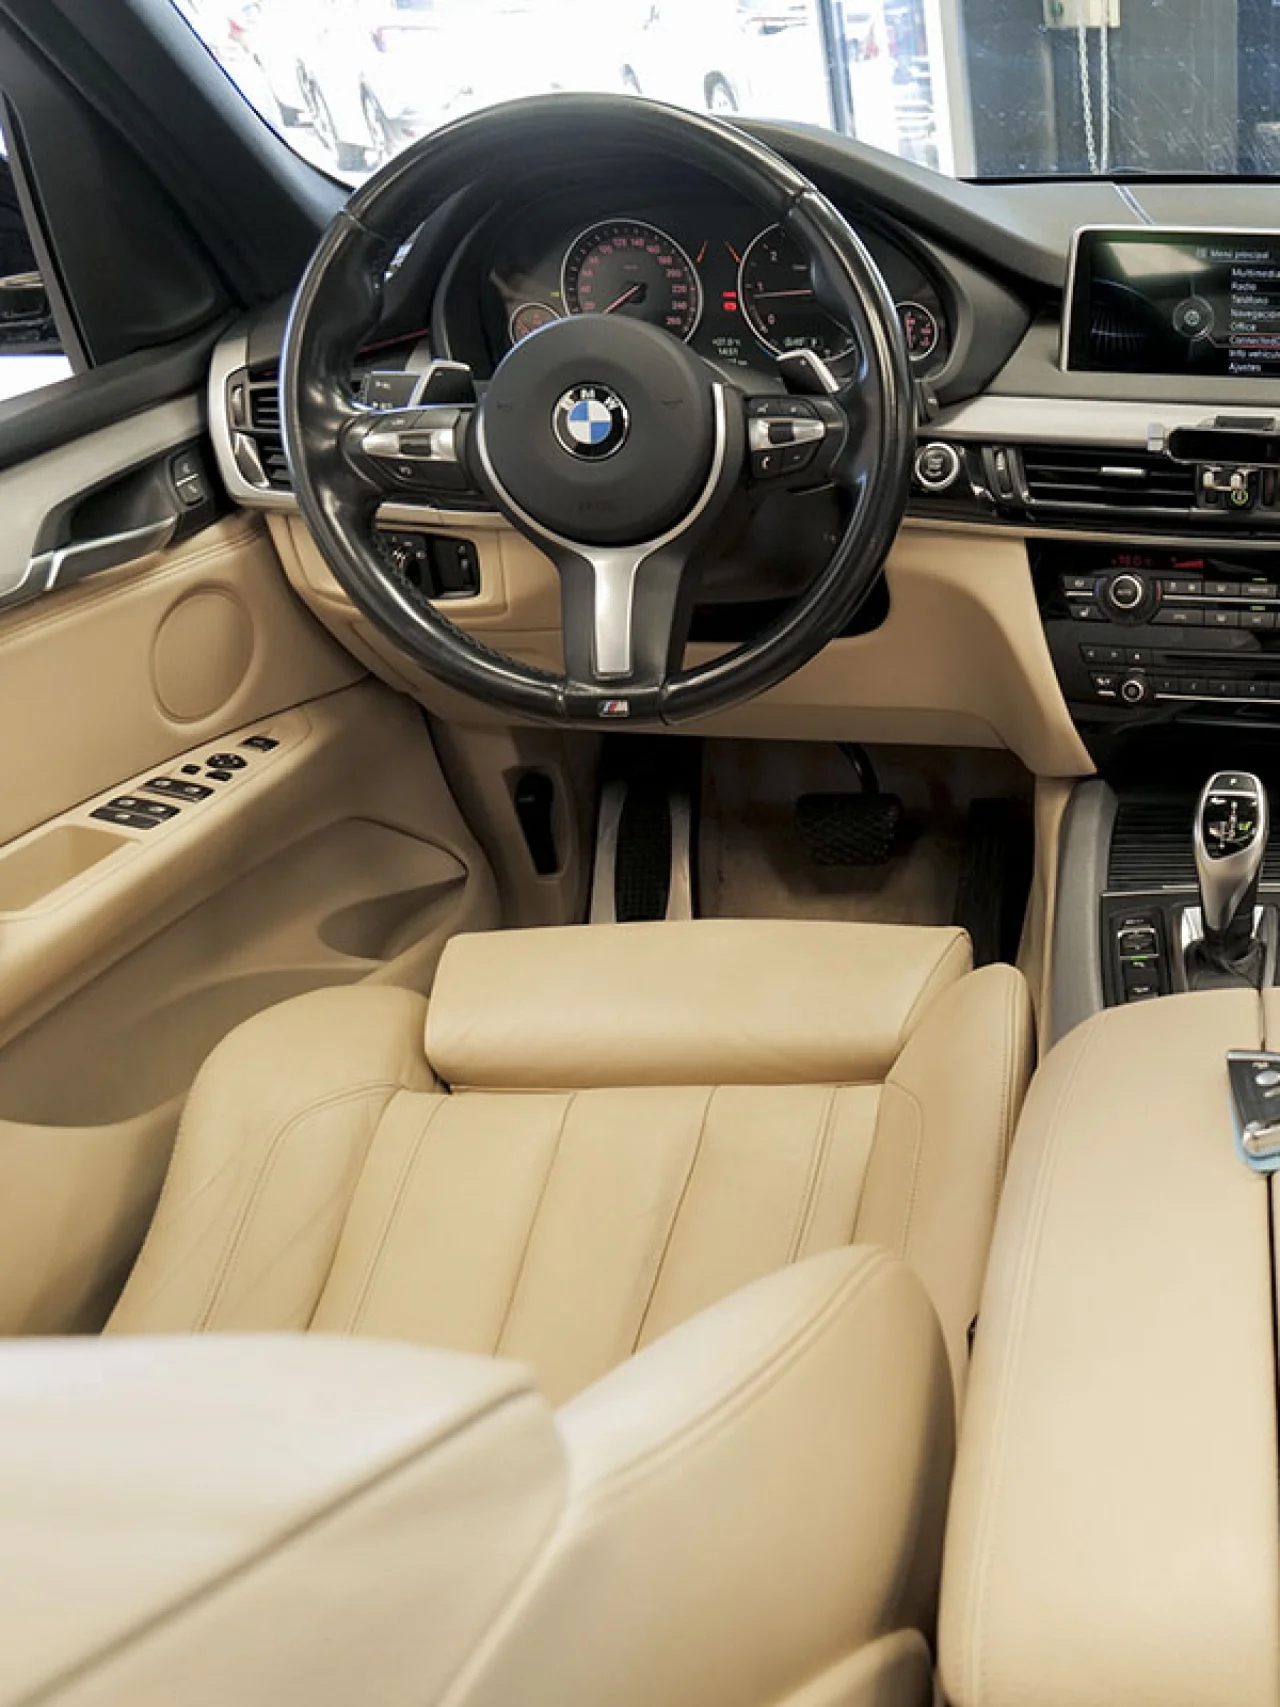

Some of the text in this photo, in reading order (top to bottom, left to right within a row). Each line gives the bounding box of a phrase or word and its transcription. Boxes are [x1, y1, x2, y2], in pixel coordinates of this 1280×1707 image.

[769, 250, 778, 262] 2
[1231, 268, 1280, 278] Multimedia
[1231, 282, 1257, 291] Radio
[1230, 321, 1257, 331] Office
[1229, 349, 1247, 358] Info
[1229, 362, 1261, 373] Ajustes
[559, 388, 622, 410] BMW
